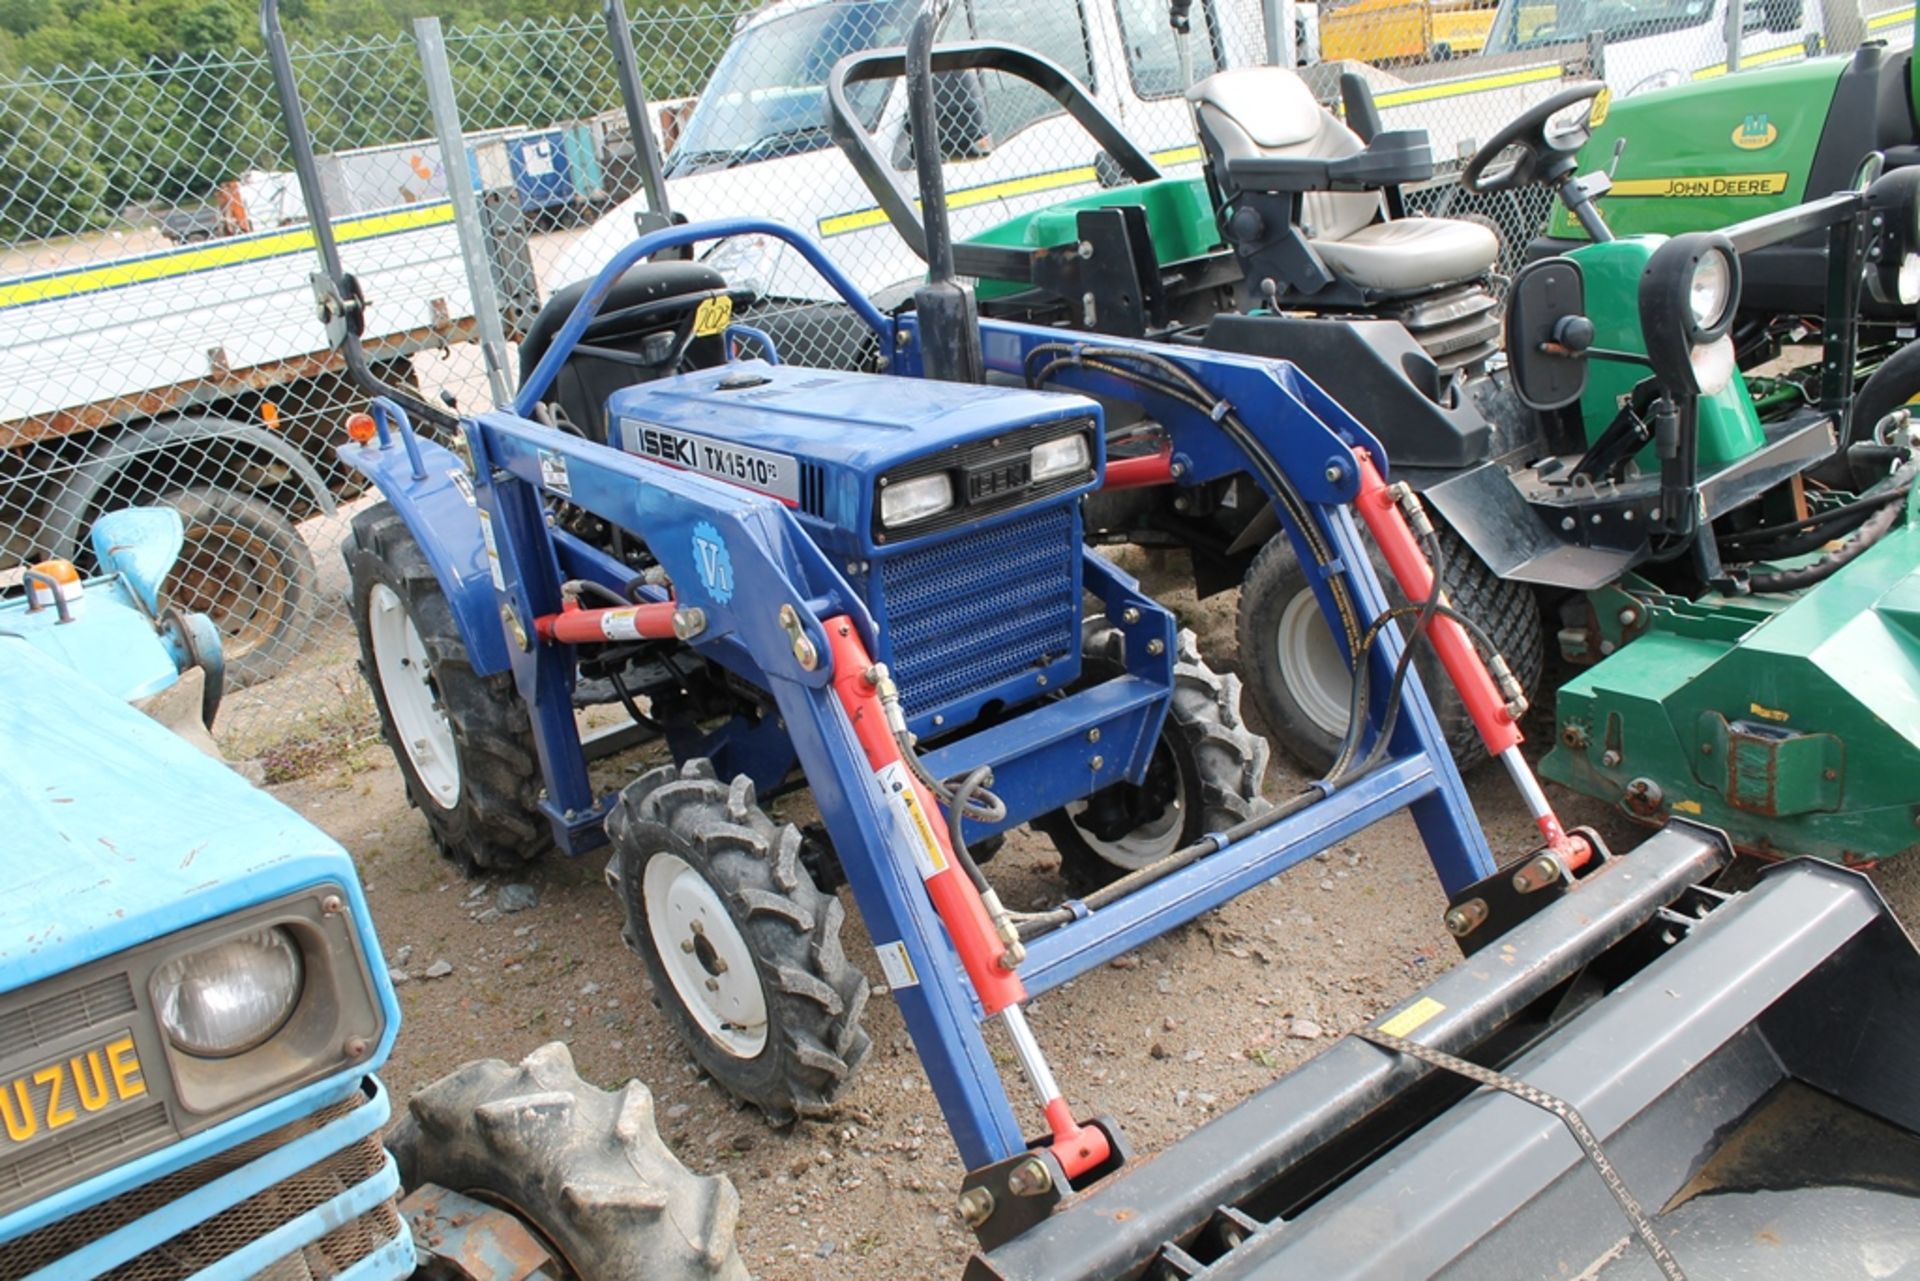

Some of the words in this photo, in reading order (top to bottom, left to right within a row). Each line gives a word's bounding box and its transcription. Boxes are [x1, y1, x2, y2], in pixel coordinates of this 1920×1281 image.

[1664, 180, 1709, 194] JOHN
[1713, 178, 1772, 194] DEERE
[639, 428, 698, 467] ISEKI
[0, 1037, 147, 1142] UZUE
